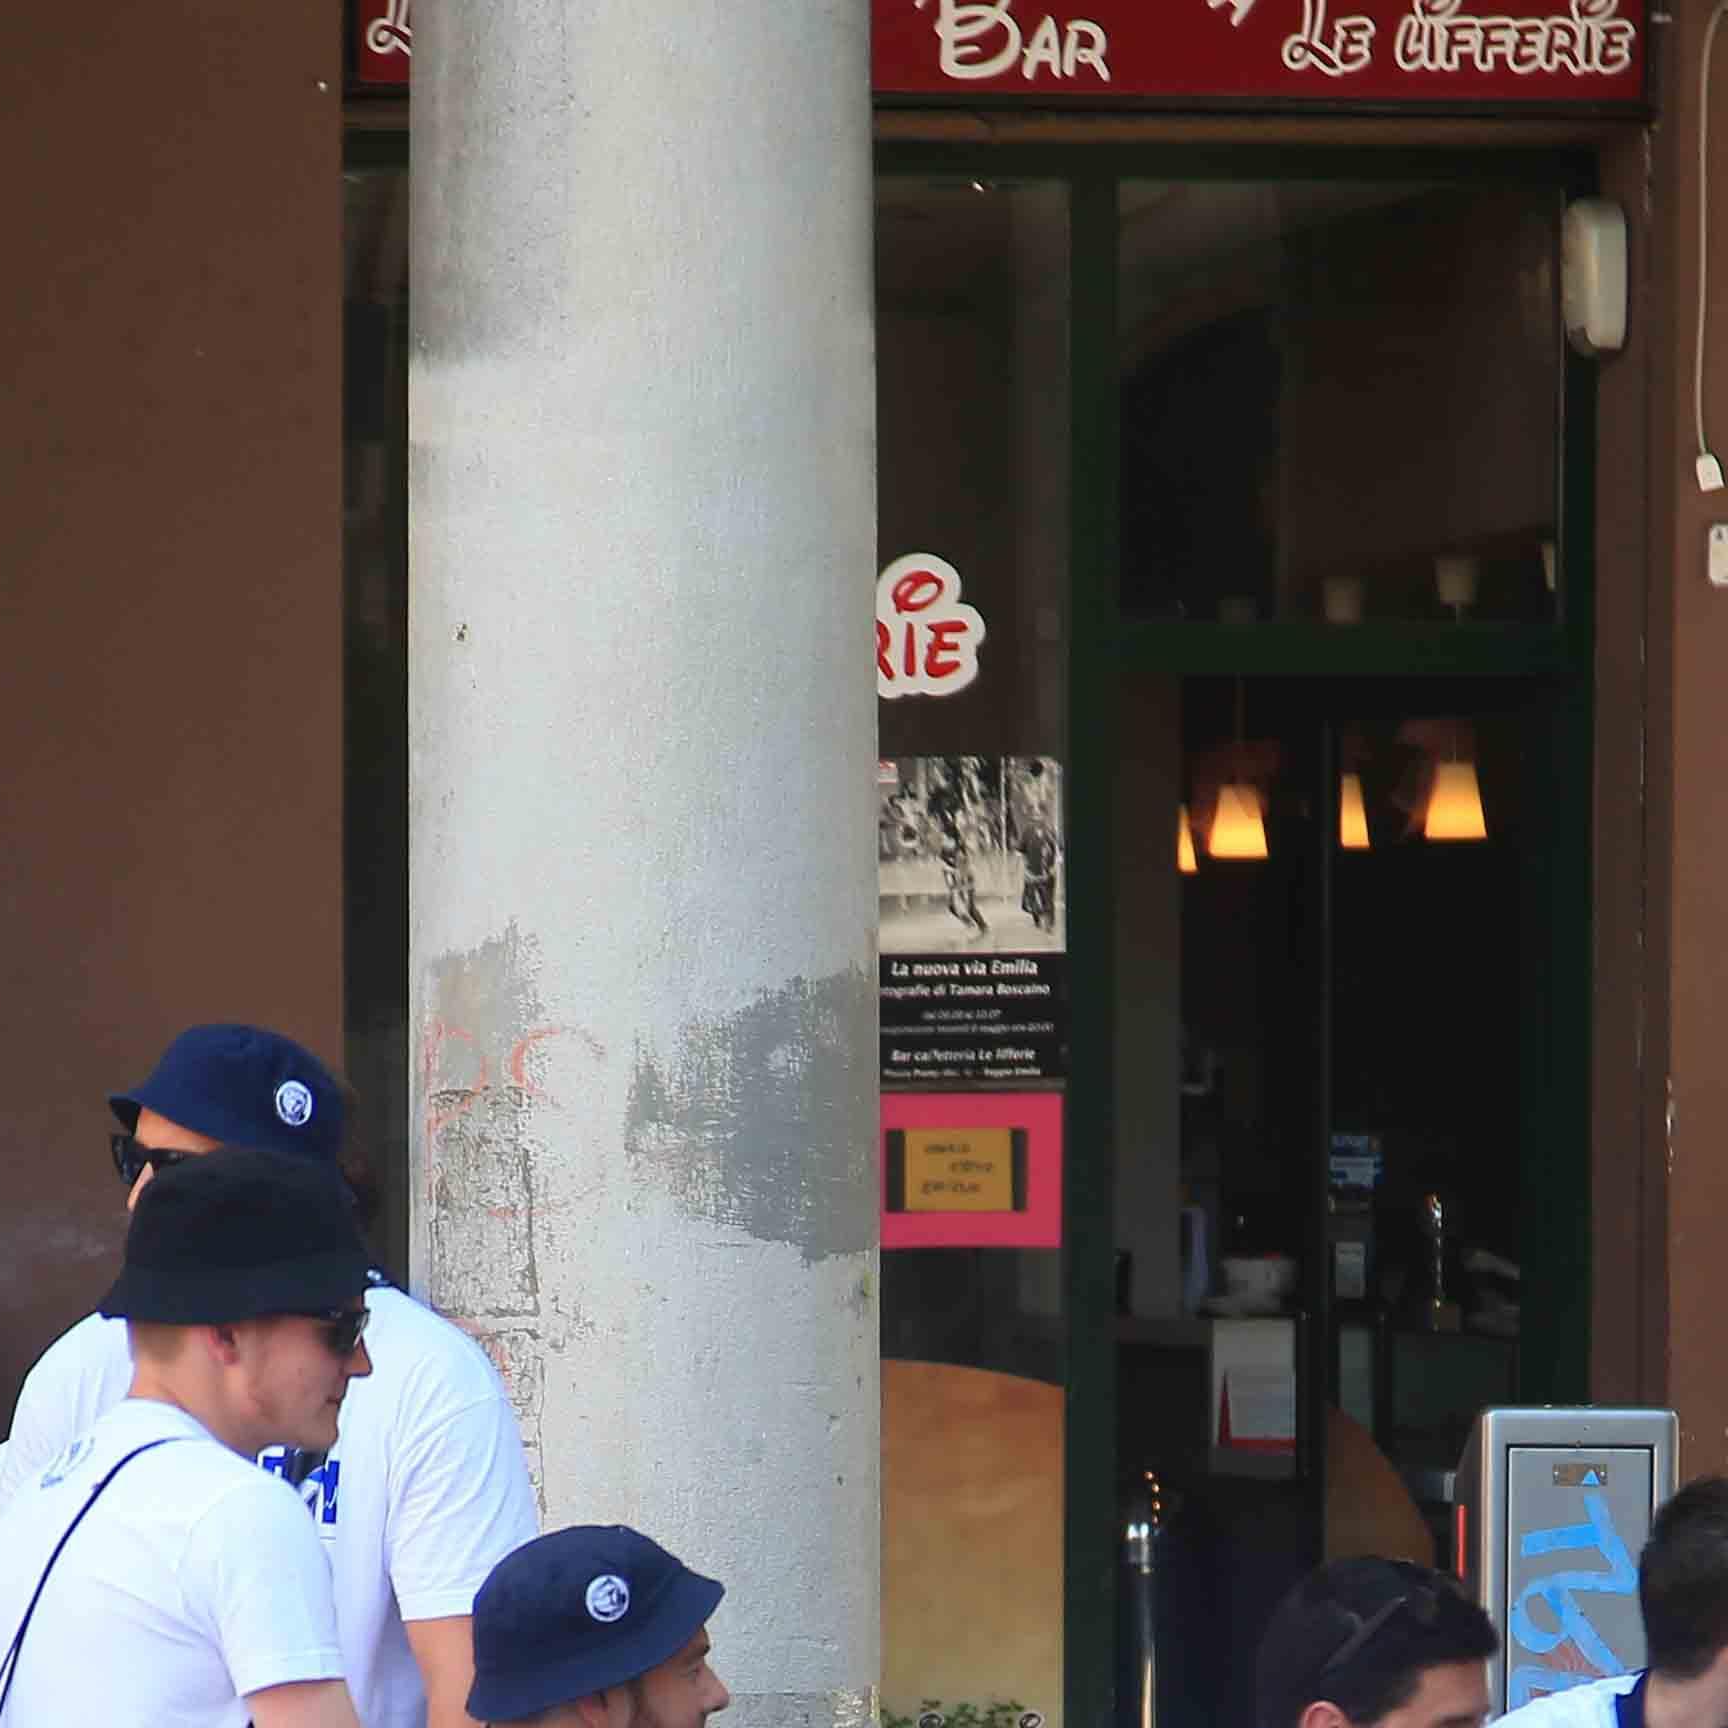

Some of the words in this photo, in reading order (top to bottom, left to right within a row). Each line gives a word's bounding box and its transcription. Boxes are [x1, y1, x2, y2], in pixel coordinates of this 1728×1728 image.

[891, 961, 909, 976] La
[912, 963, 960, 976] nuova
[964, 960, 987, 976] via
[991, 959, 1038, 975] Emilia
